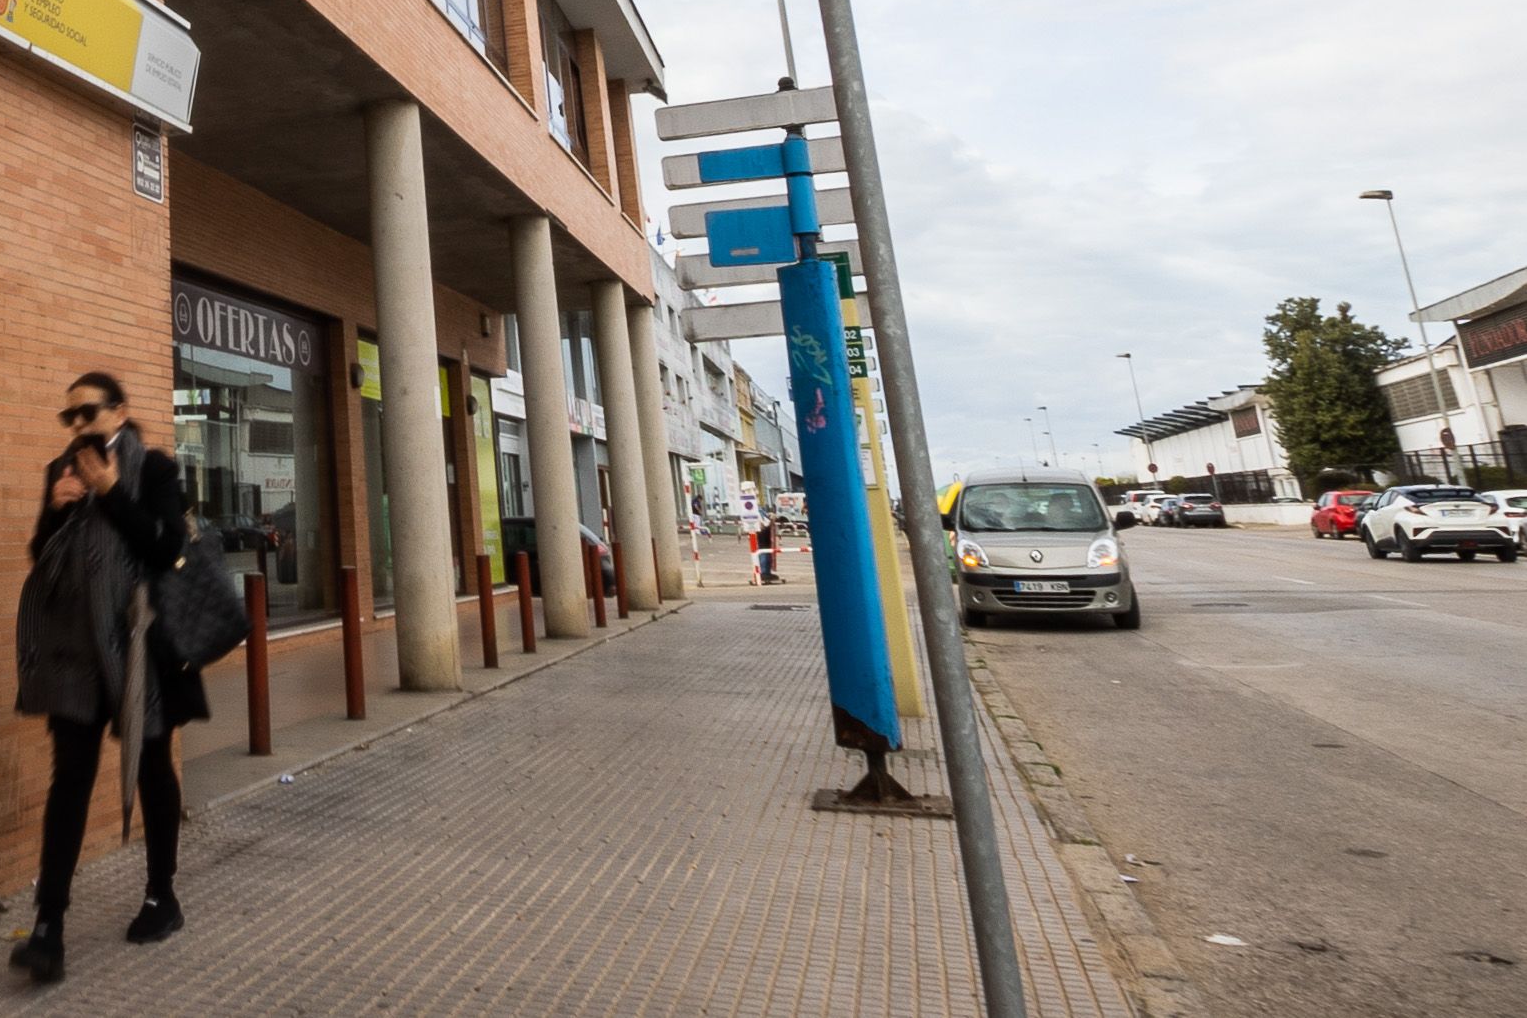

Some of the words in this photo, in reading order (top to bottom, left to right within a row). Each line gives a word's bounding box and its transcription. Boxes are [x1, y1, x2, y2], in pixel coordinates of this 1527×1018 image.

[29, 5, 66, 34] SEGURIDAD
[66, 26, 87, 47] SOCIAL
[196, 296, 296, 365] OFERTAS
